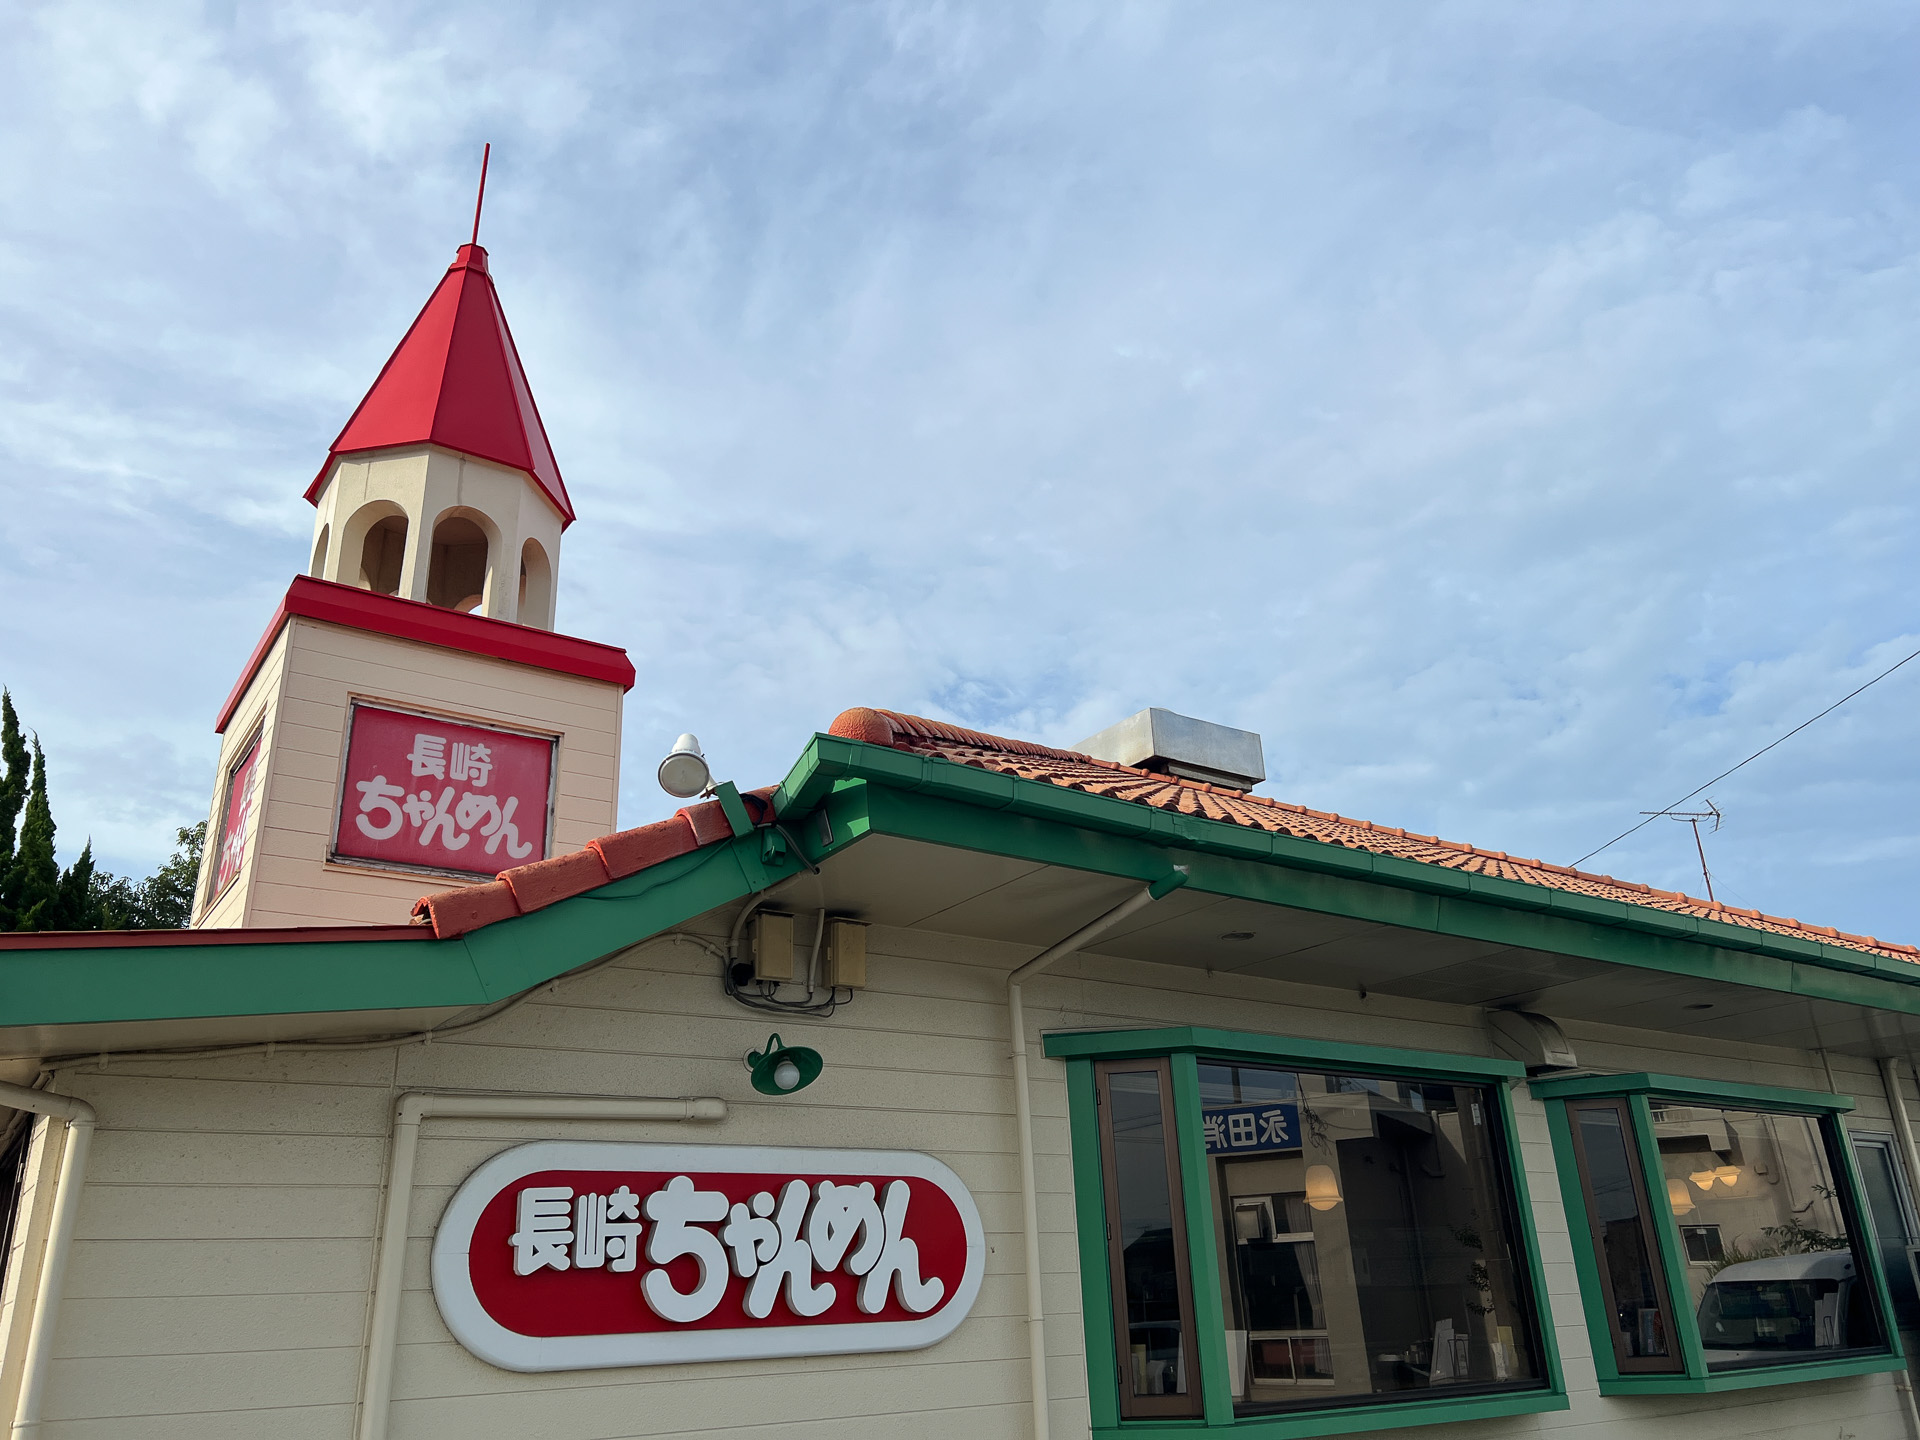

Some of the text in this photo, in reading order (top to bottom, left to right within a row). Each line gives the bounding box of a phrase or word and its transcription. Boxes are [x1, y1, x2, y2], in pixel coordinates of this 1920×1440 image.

[407, 733, 493, 787] 長崎
[356, 775, 533, 859] ちゃんめん
[508, 1175, 944, 1322] 長崎ちゃんめん
